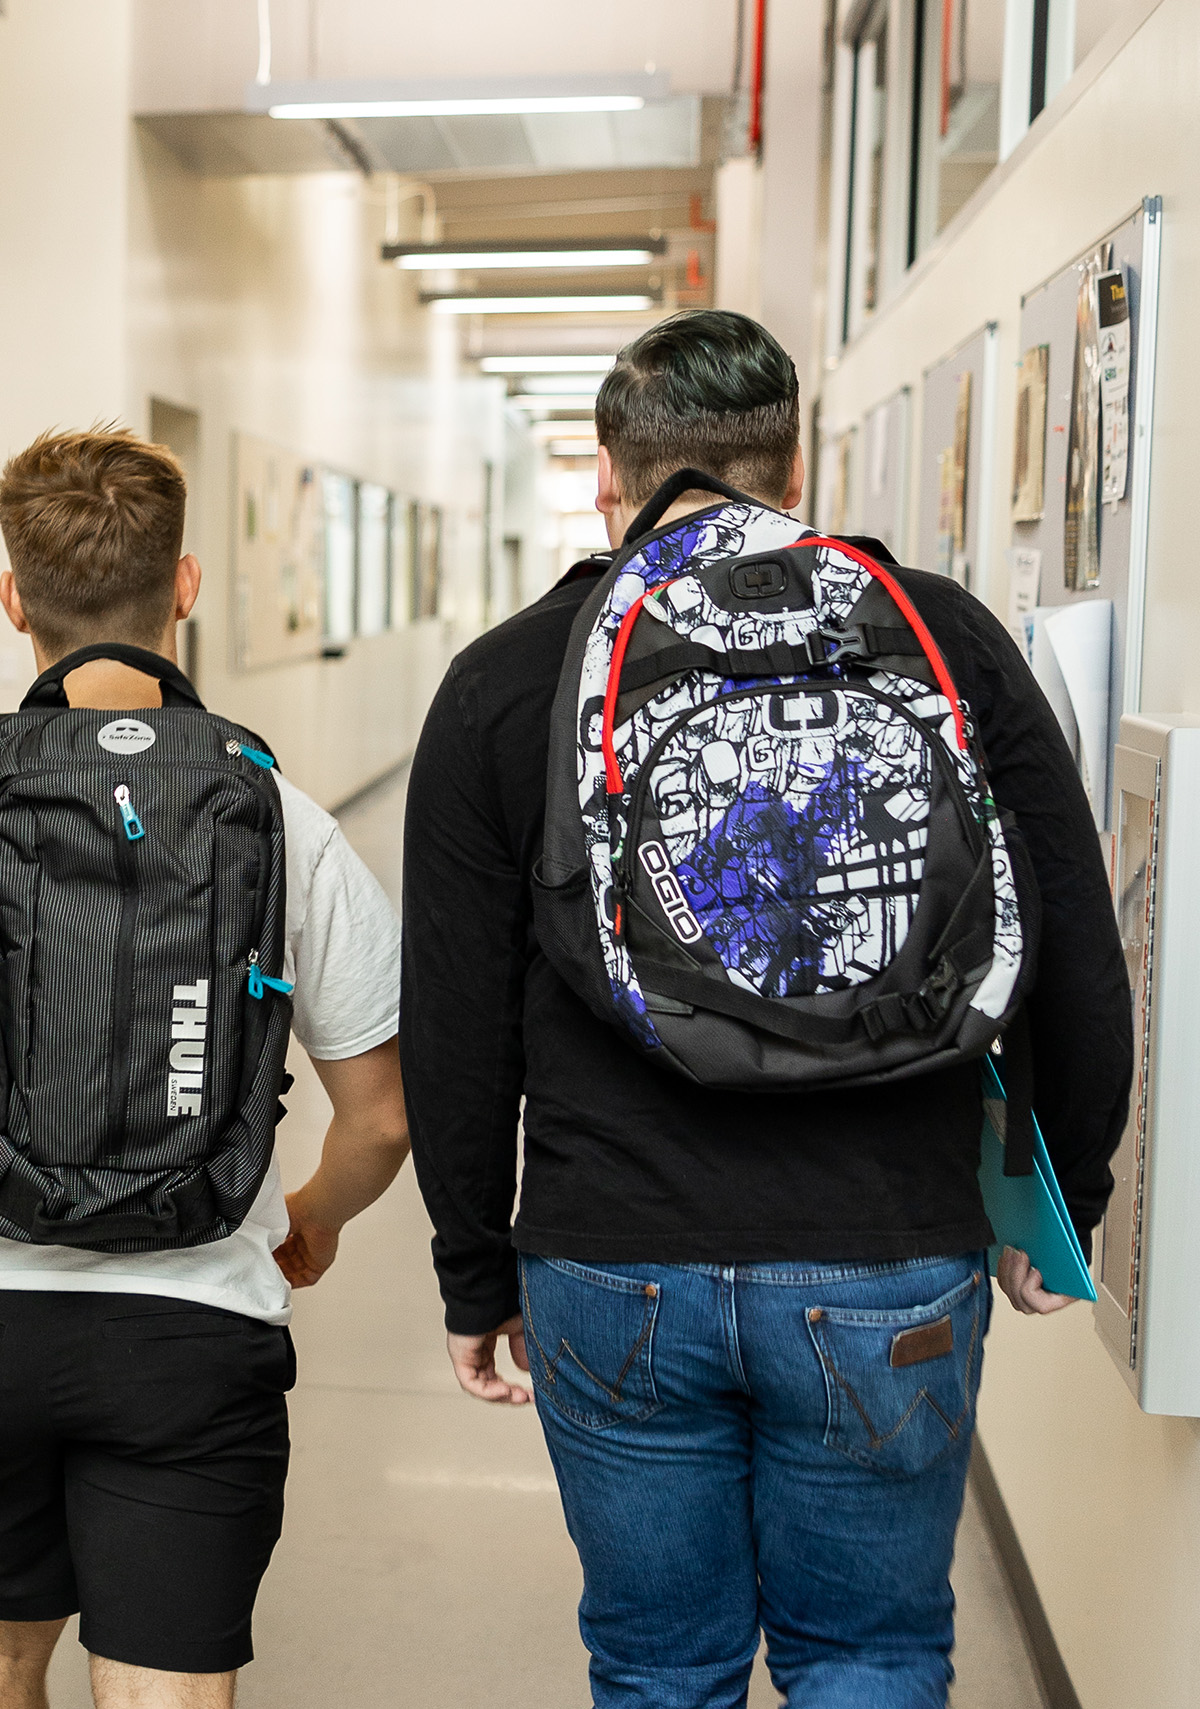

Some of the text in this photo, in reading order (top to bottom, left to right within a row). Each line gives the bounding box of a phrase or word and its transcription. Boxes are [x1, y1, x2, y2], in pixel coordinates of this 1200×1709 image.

[638, 841, 703, 944] OGIO
[167, 979, 209, 1116] THULE
[169, 1078, 178, 1112] SWEDEN
